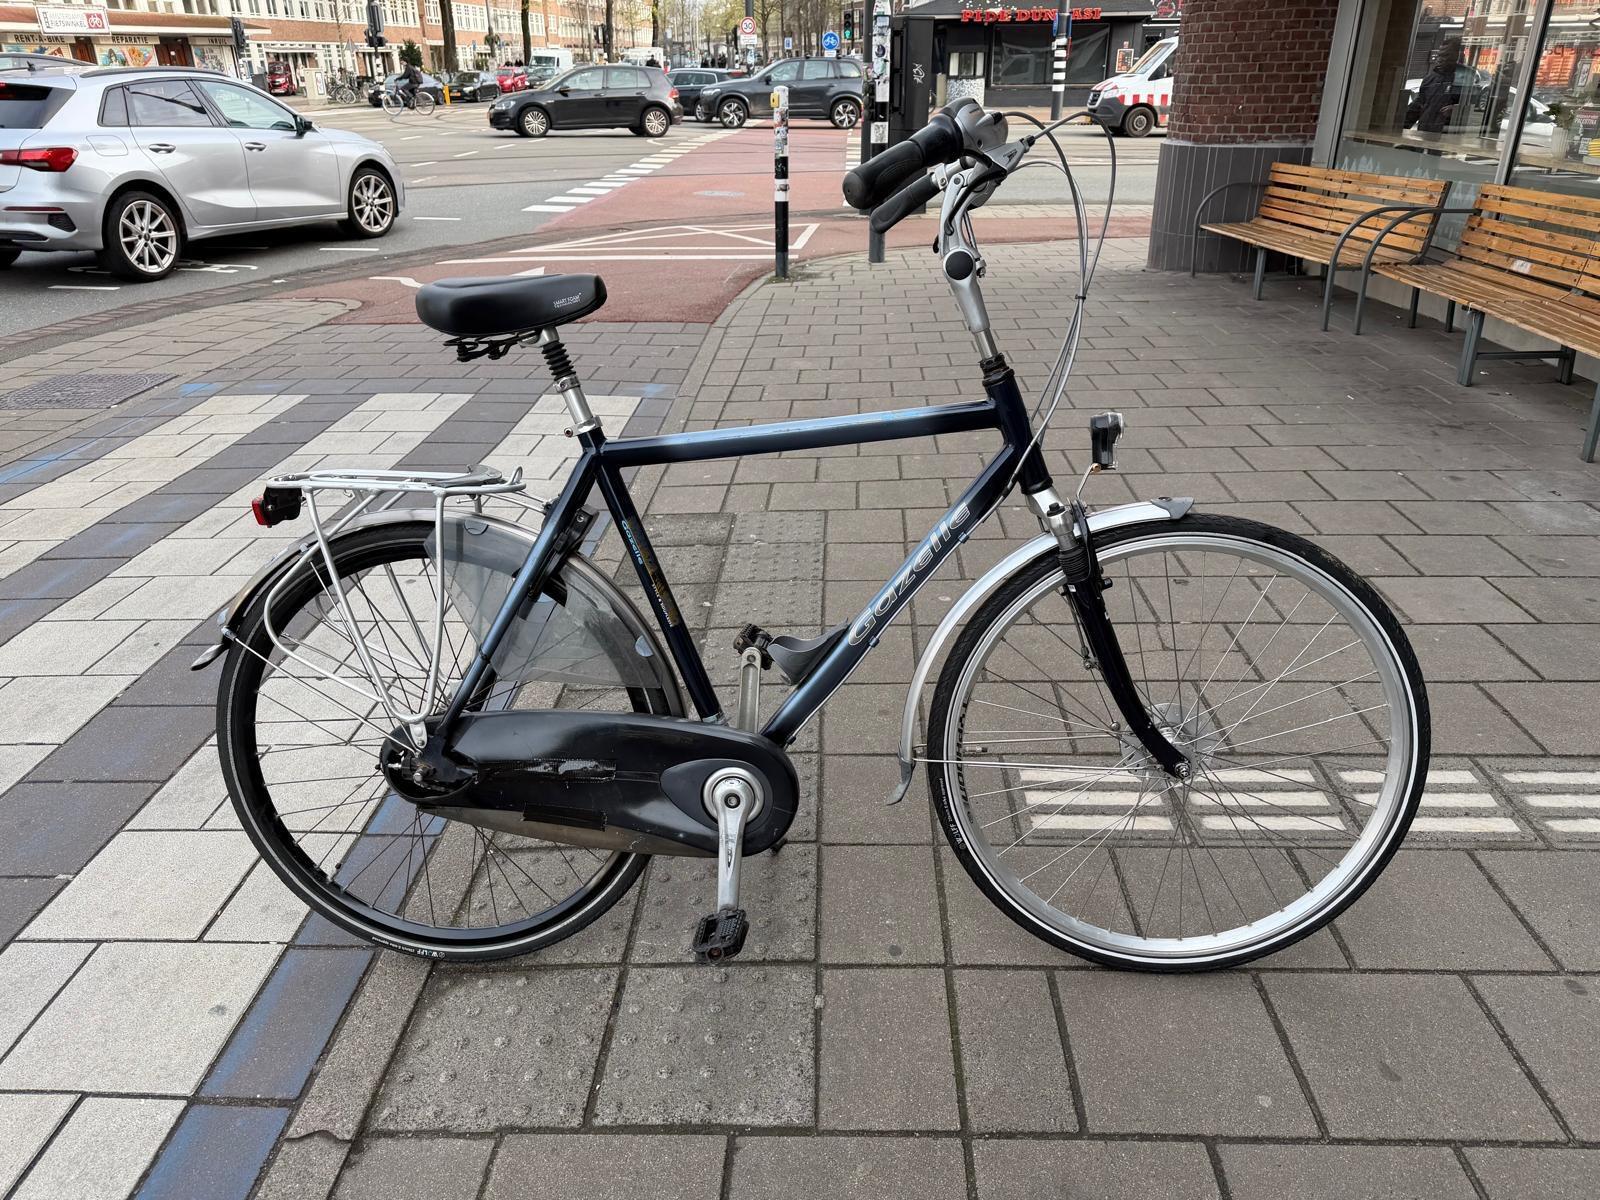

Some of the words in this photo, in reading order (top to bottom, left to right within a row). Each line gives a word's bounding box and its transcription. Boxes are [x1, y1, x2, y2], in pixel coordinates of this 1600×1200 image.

[961, 9, 1011, 22] PIDE
[1016, 6, 1102, 21] DÜNASI
[743, 22, 753, 30] 30
[112, 36, 149, 44] REPARATIE
[621, 520, 644, 566] Gazelle
[848, 502, 971, 646] Gazelle
